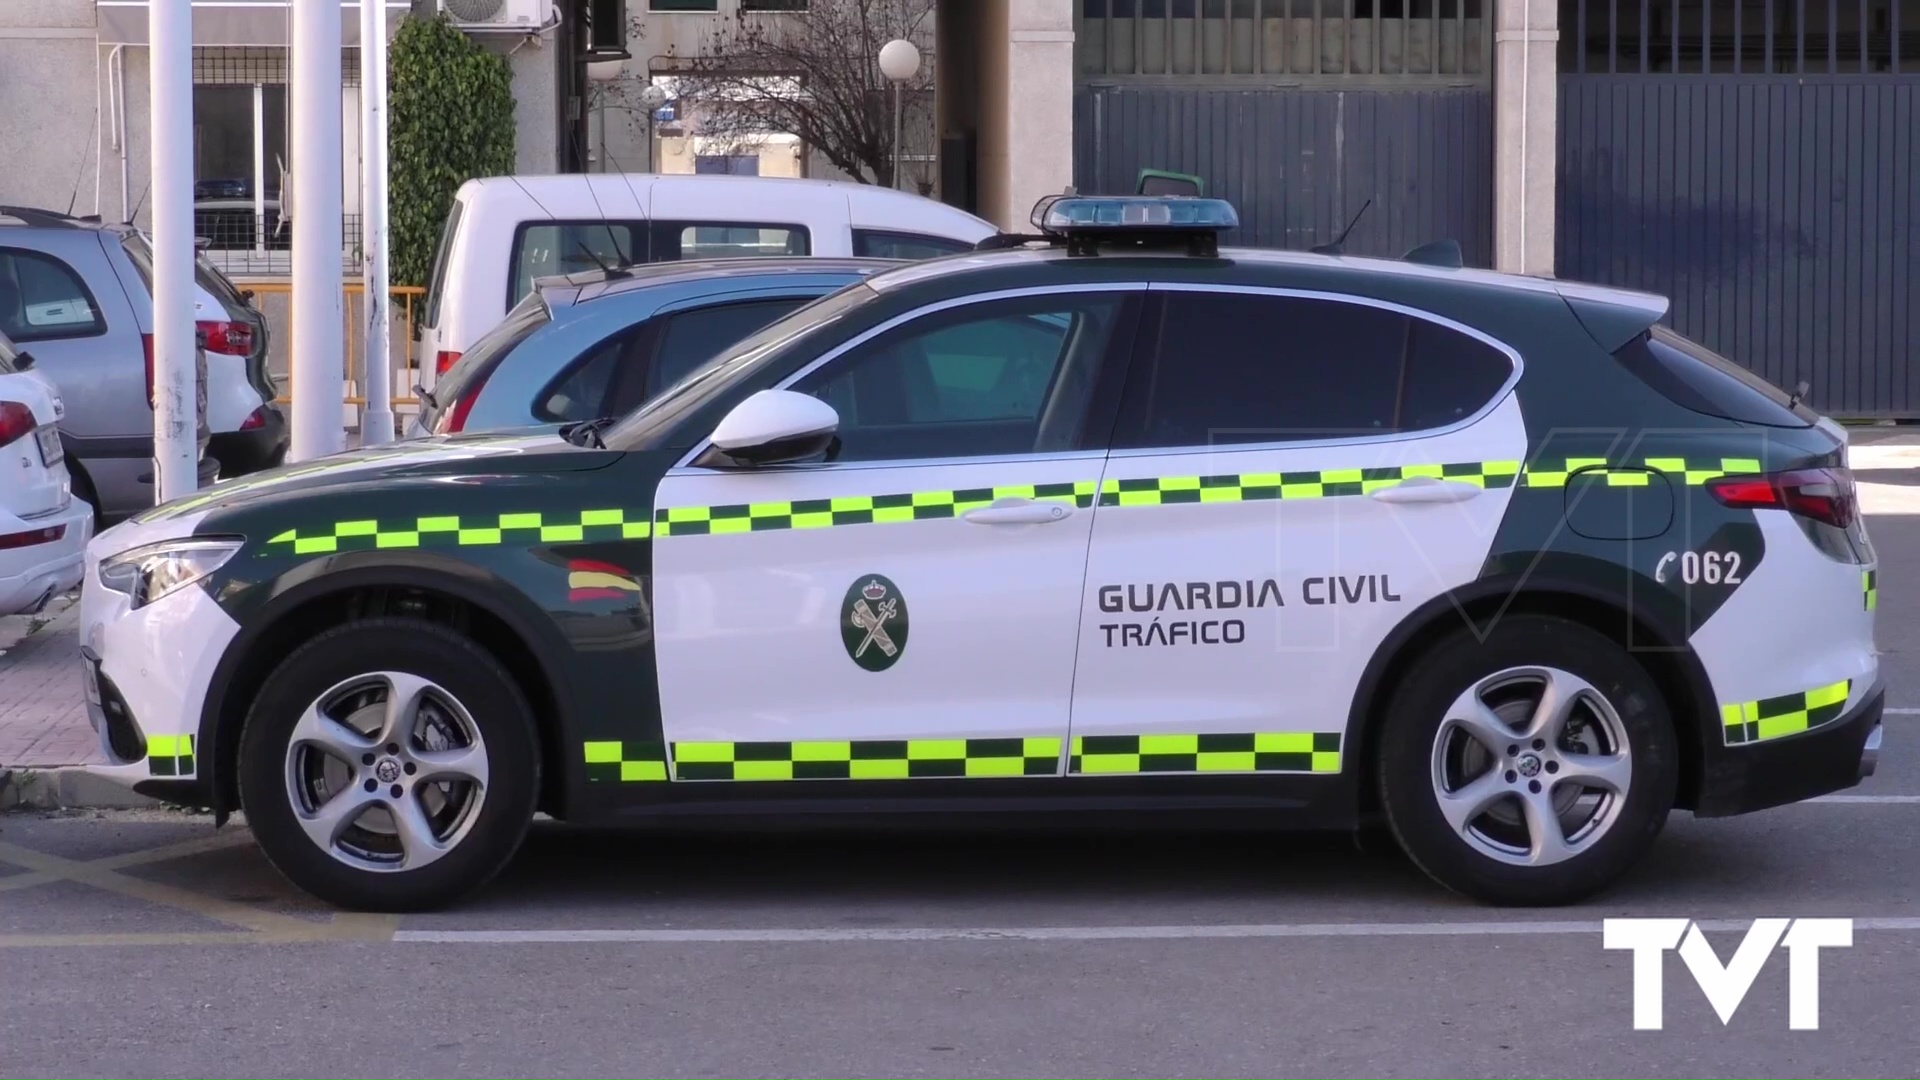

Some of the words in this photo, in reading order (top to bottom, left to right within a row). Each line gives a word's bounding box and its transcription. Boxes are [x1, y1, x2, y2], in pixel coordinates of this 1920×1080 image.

[1682, 551, 1741, 584] 062
[1098, 579, 1285, 612] GUARDIA
[1302, 574, 1401, 605] CIVIL
[1100, 616, 1245, 647] TRÁFICO
